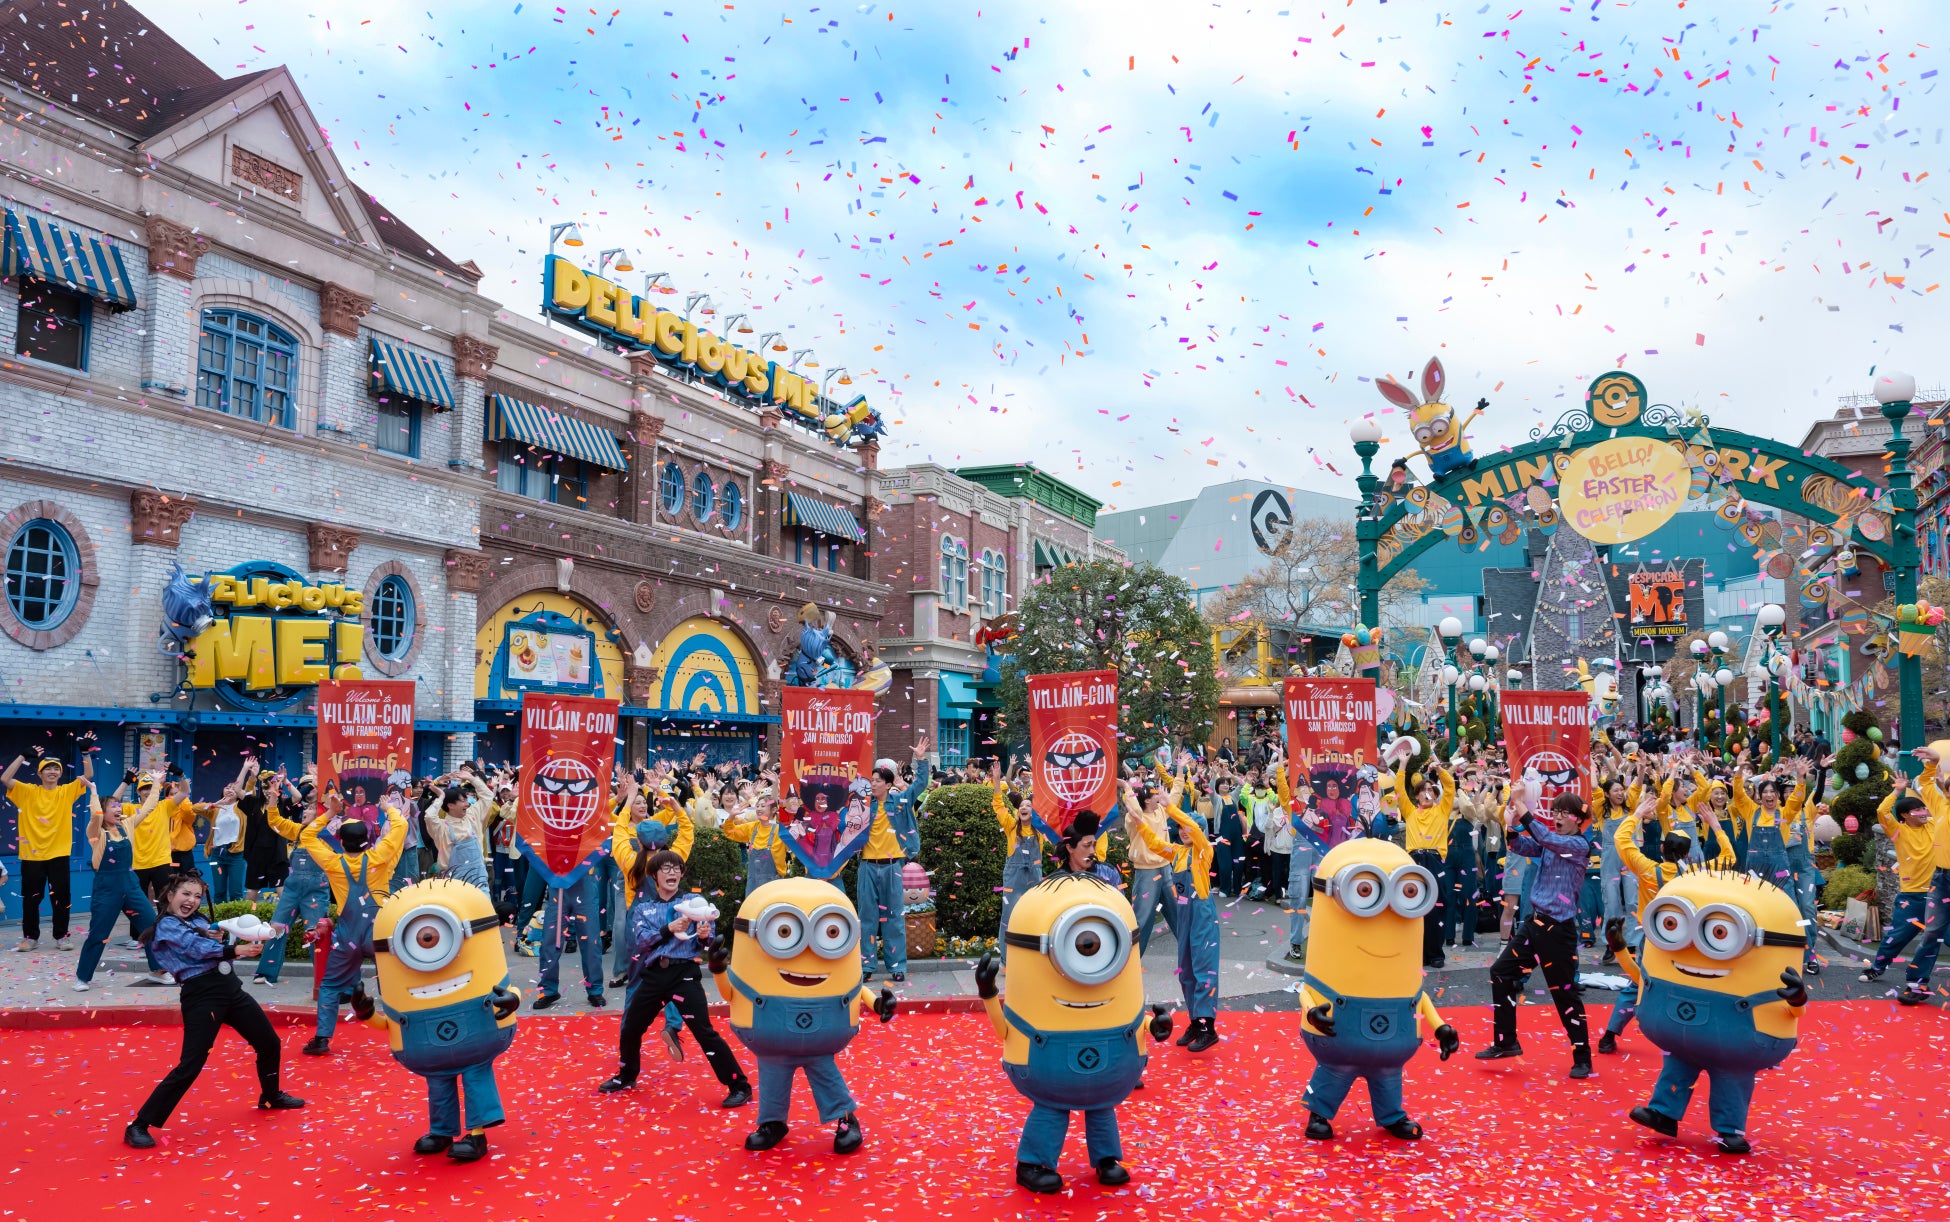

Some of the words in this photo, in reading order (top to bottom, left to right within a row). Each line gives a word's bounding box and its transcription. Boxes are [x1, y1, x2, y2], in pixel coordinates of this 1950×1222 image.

[554, 258, 769, 394] DELICIOUS
[1588, 443, 1654, 478] BELLO!
[1690, 444, 1790, 490] RK
[1583, 474, 1659, 501] EASTER
[1576, 486, 1679, 529] CELEBRATION
[188, 575, 365, 615] ELICIOUS
[1659, 627, 1685, 635] MAYHEM
[177, 615, 365, 691] ME!
[346, 689, 380, 703] Welcome
[808, 697, 842, 712] Welcome
[843, 702, 852, 711] to
[1032, 684, 1115, 709] VILLAIN-CON
[1310, 687, 1344, 700] Welcome
[1345, 691, 1354, 700] to
[322, 703, 411, 725] VILLAIN-CON
[526, 708, 615, 734] VILLAIN-CON
[1289, 699, 1374, 721] VILLAIN-CON
[1503, 704, 1586, 726] VILLAIN-CON
[341, 725, 355, 737] SAN
[356, 725, 392, 737] FRANCISCO
[786, 710, 871, 733] VILLAIN-CON
[1308, 721, 1322, 732] SAN
[1323, 721, 1357, 733] FRANCISCO
[803, 731, 817, 744] SAN
[818, 731, 853, 745] FRANCISCO
